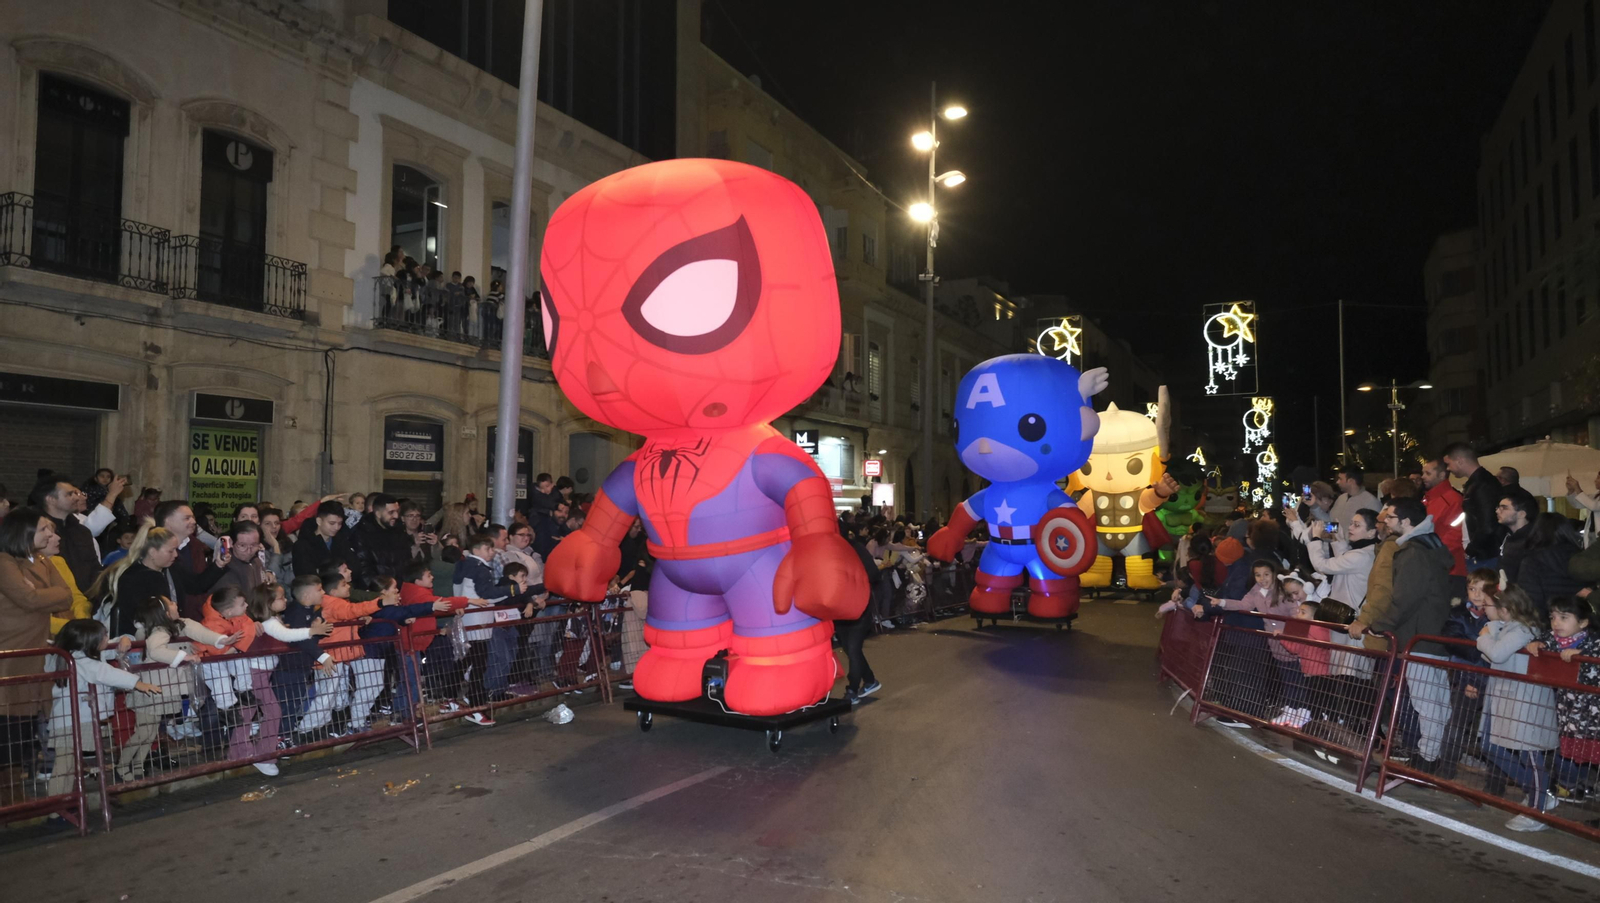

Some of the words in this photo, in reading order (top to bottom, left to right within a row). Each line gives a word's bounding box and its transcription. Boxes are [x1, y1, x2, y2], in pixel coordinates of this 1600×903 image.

[966, 373, 1006, 409] A
[192, 432, 210, 451] SE
[214, 434, 258, 453] VENDE
[392, 442, 430, 451] DISPONIBLE
[389, 451, 405, 459] 950
[405, 452, 415, 460] 27
[192, 457, 200, 475] O
[205, 458, 257, 476] ALQUILA
[192, 480, 225, 490] Superficie
[192, 491, 220, 499] Fachada
[221, 492, 252, 501] Protegida
